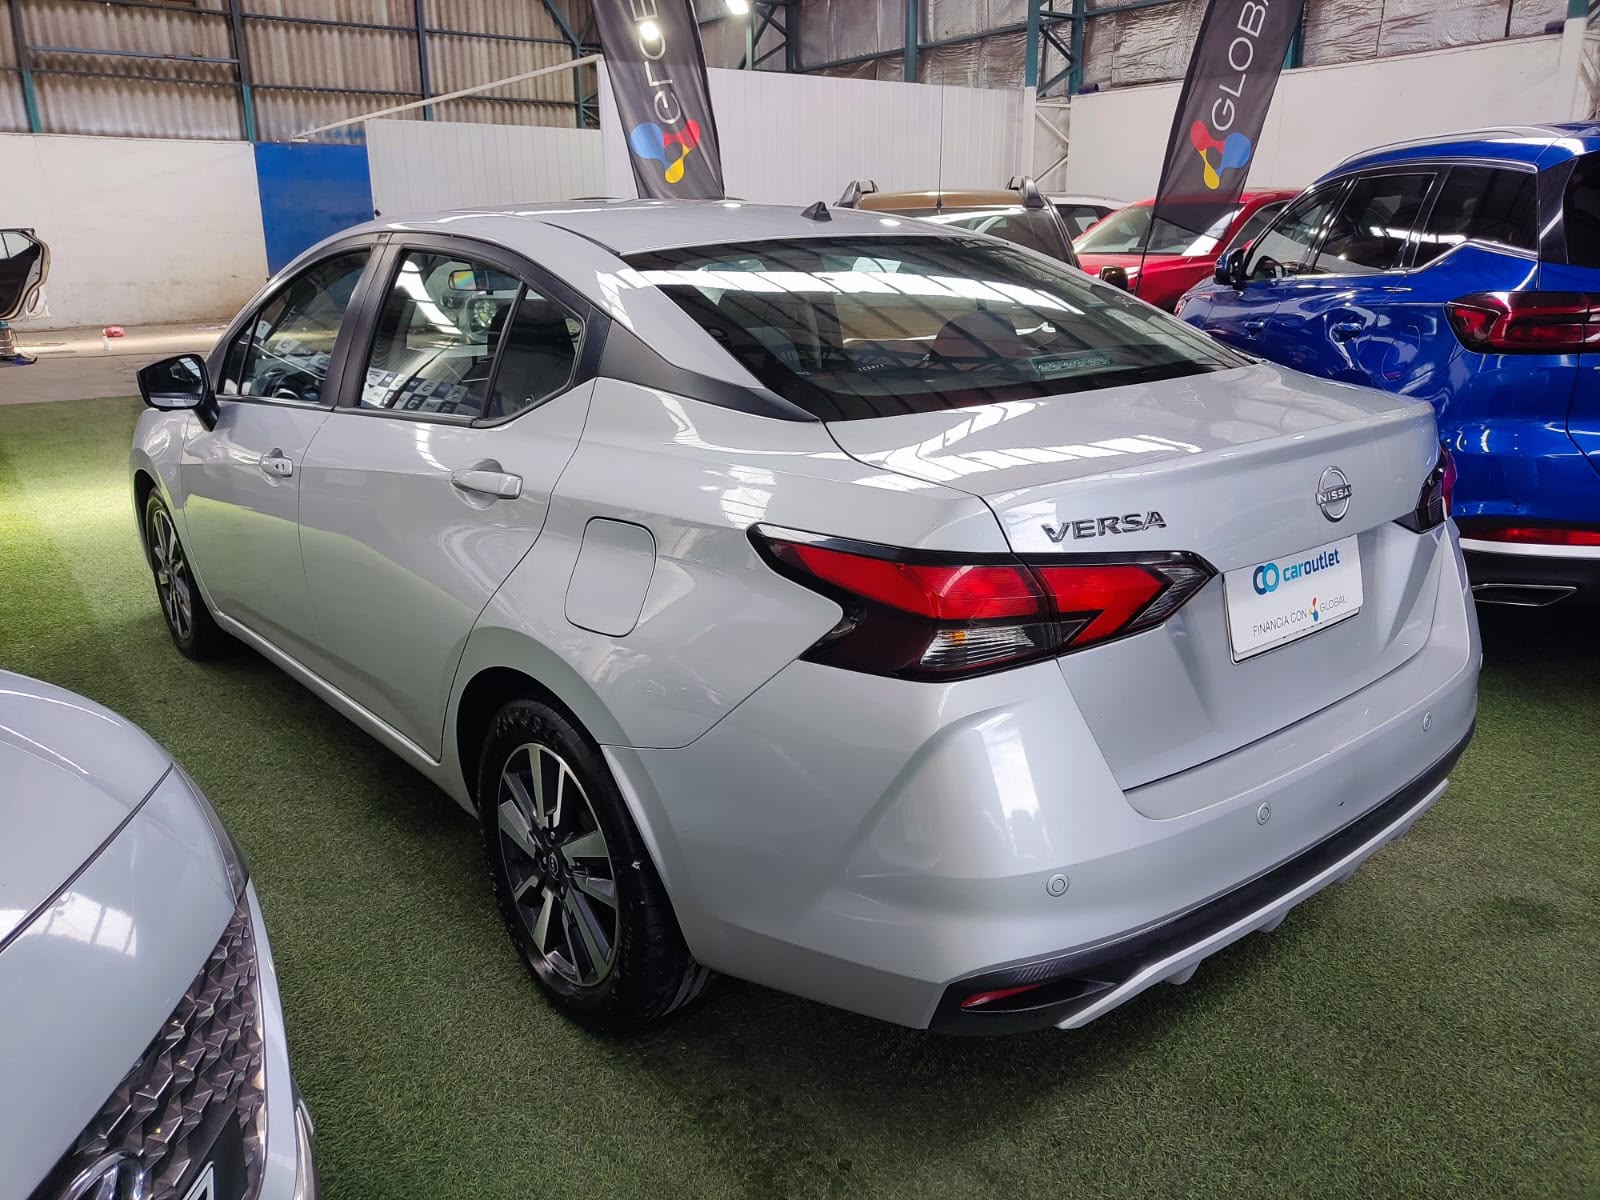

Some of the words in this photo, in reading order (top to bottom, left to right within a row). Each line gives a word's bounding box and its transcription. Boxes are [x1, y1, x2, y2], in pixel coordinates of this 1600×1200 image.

[1211, 0, 1270, 131] GLOB
[1040, 511, 1168, 543] VERSA
[1282, 548, 1341, 582] caroutlet
[1252, 614, 1290, 637] FINANCIA
[1290, 608, 1308, 624] CON
[1319, 594, 1347, 613] GLOBAL
